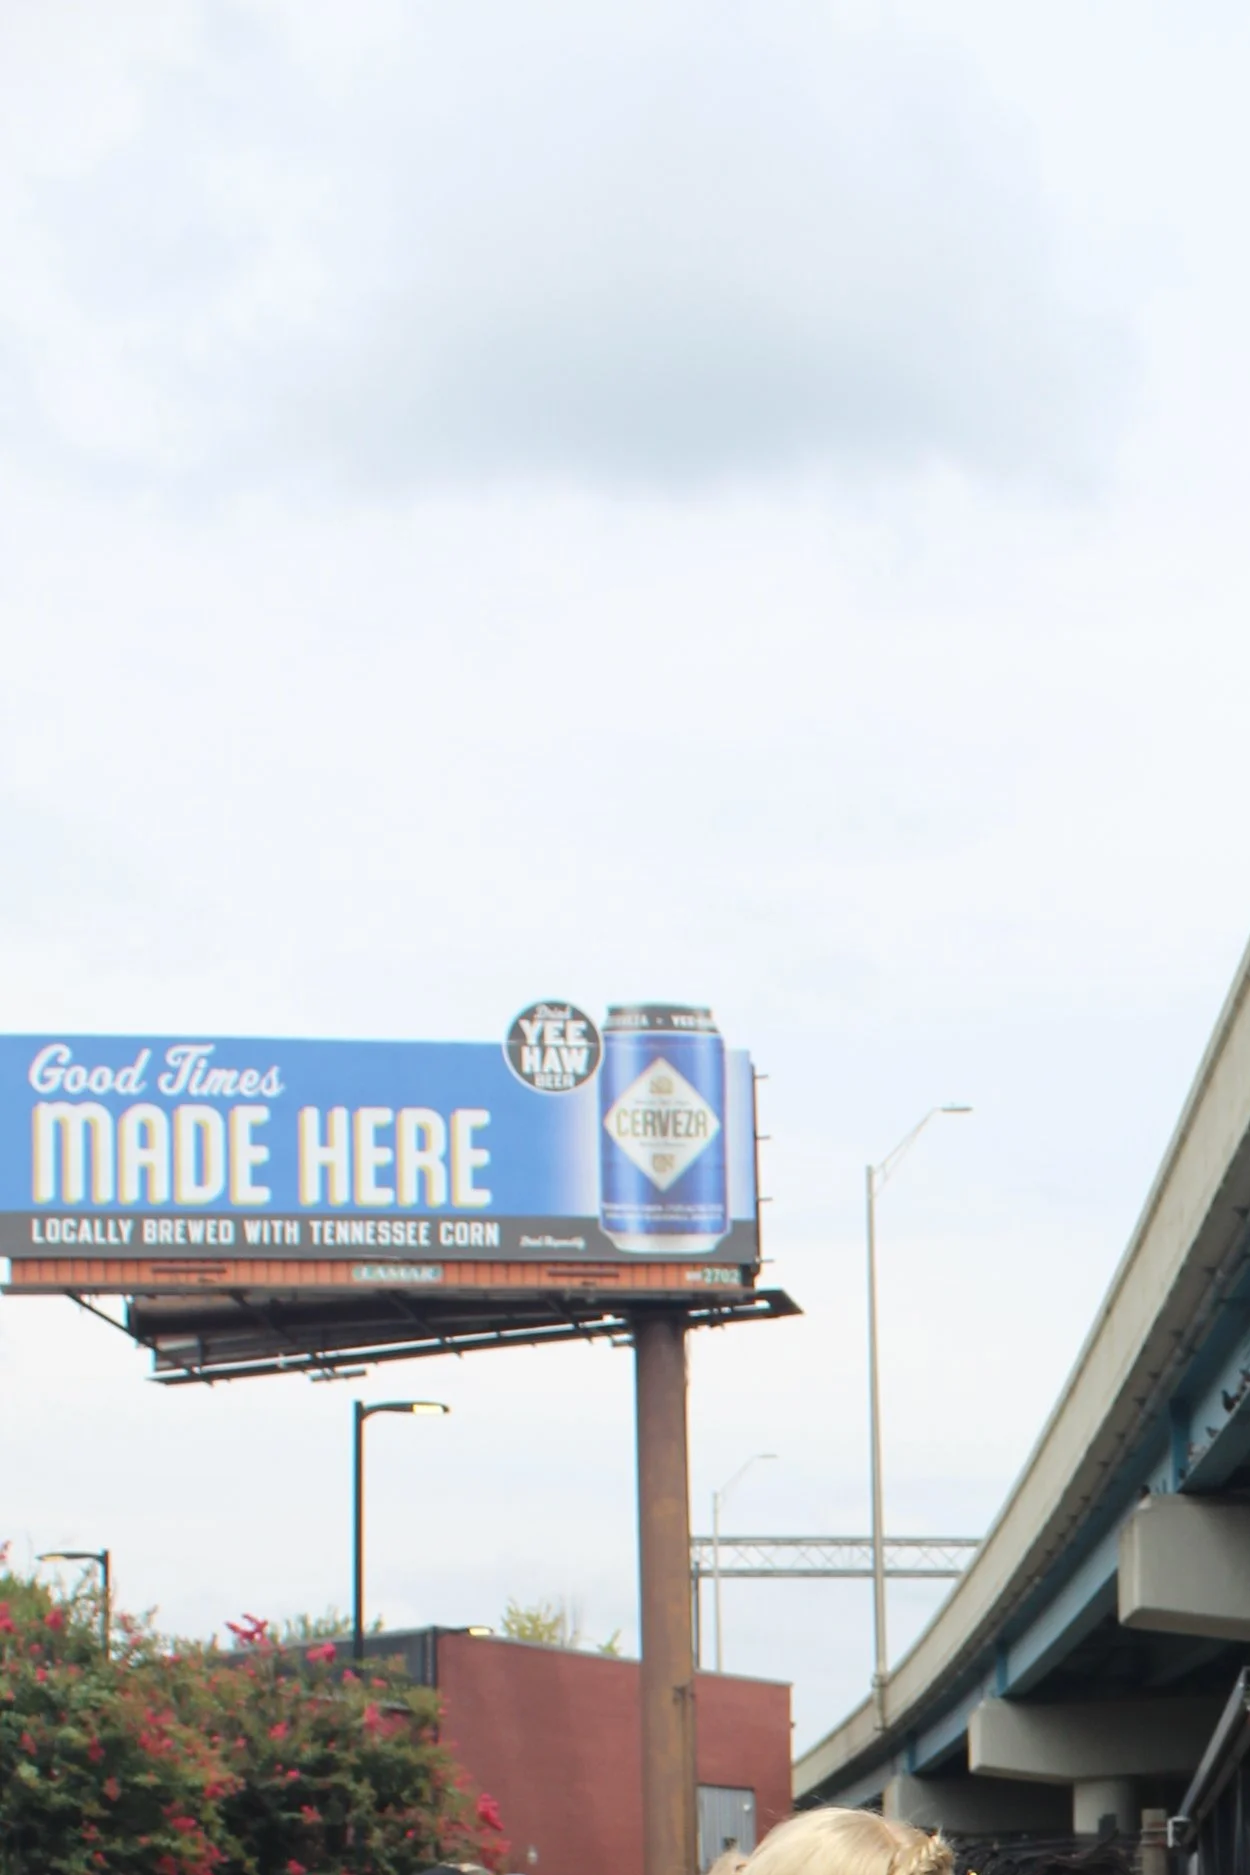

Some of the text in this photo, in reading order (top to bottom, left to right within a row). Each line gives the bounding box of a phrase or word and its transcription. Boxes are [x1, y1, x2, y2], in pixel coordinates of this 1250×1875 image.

[518, 1018, 588, 1045] YEE
[28, 1043, 284, 1098] Good Times
[521, 1046, 591, 1074] HAW
[534, 1073, 575, 1089] BEER
[615, 1108, 709, 1138] CERVEZA
[32, 1101, 492, 1209] MADE HERE
[31, 1217, 134, 1244] LOCALLY
[142, 1218, 235, 1245] BREWED
[243, 1219, 300, 1246] WITH
[309, 1220, 430, 1247] TENNESSEE
[439, 1221, 500, 1247] CORN
